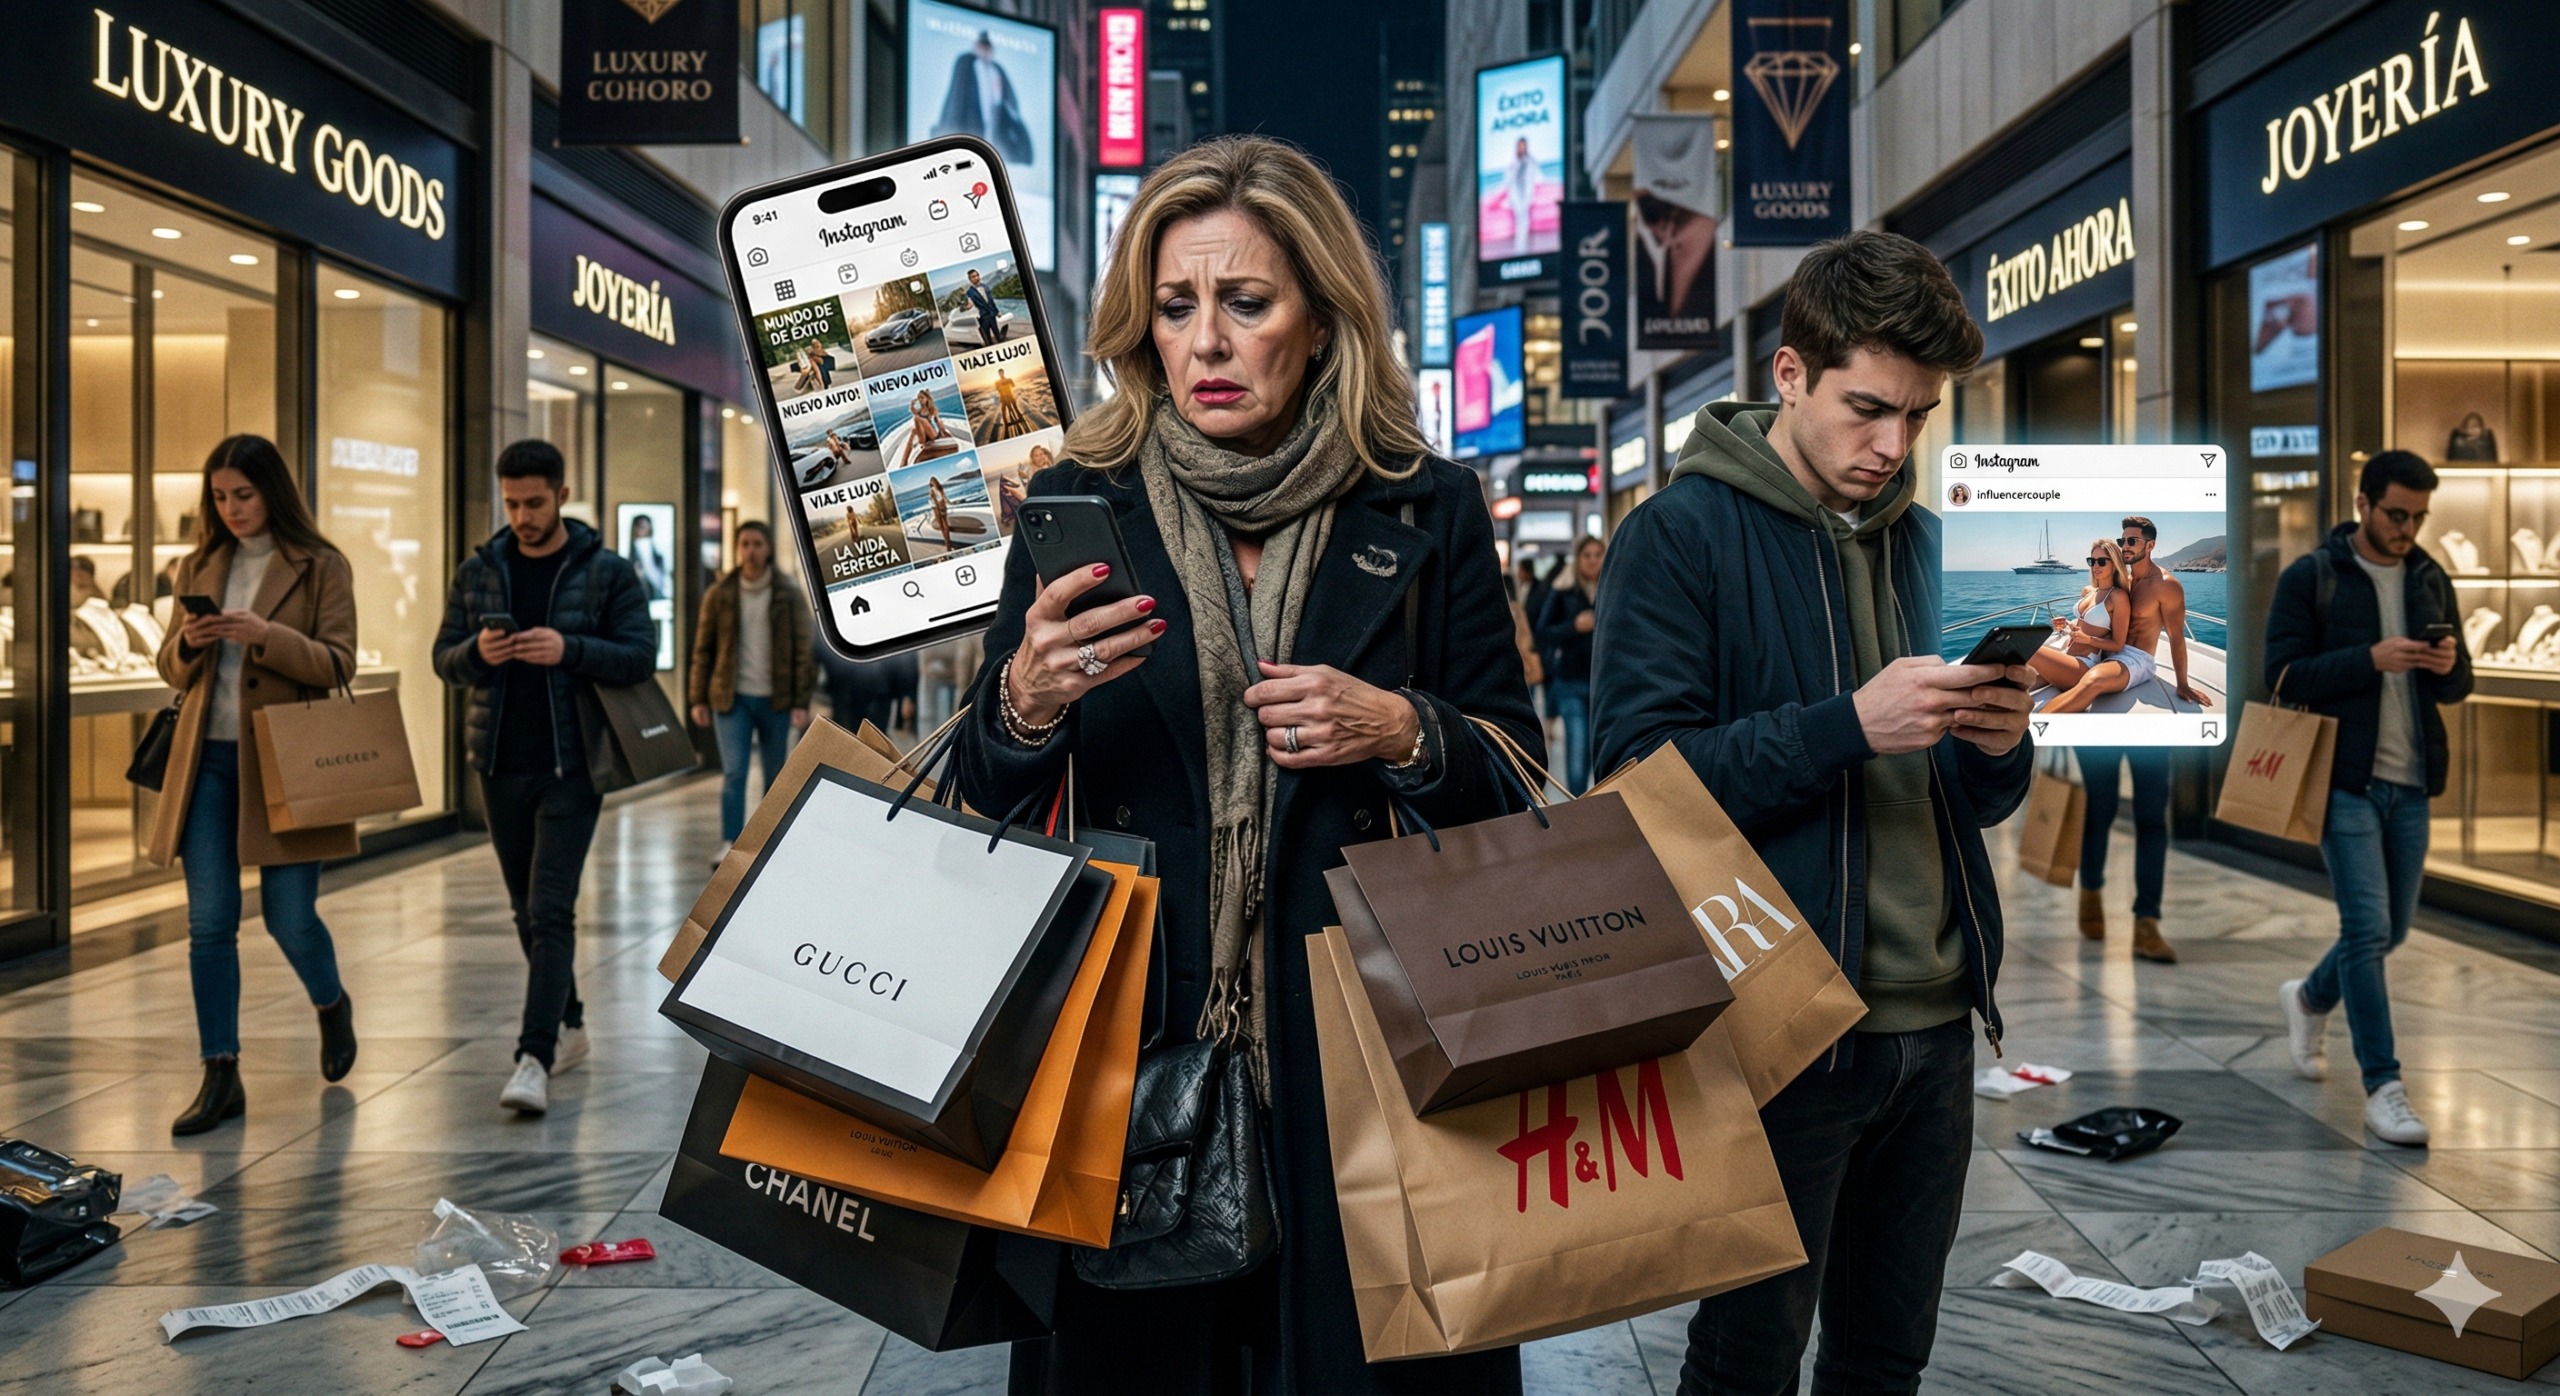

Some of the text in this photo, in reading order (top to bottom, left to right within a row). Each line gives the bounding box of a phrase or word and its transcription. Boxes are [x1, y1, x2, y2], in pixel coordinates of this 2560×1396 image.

[593, 51, 708, 73] LUXURY
[2261, 12, 2489, 194] JOYERÍA
[93, 8, 446, 240] LUXURY GOODS
[1491, 114, 1550, 133] AHORA
[1750, 182, 1834, 199] LUXURY
[752, 210, 778, 225] 9:41
[1754, 201, 1830, 219] GOODS
[818, 213, 907, 248] Instagram
[1986, 197, 2136, 323] ÉXITO AHORA
[572, 254, 676, 346] JOYERÍA
[764, 303, 834, 331] MUNDO DE
[770, 319, 829, 346] DE ÉXITO
[958, 342, 1032, 372] VIAJE LUJO!
[867, 362, 949, 396] NUEVO AUTO!
[781, 388, 861, 419] NUEVO AUTO!
[1974, 453, 2040, 473] Instagram
[810, 479, 884, 509] VIAJE LUJO!
[1976, 489, 2061, 502] influencercouple
[834, 535, 888, 561] LA VIDA
[831, 549, 901, 578] PERFECTA
[1443, 905, 1647, 970] LOUIS VUITTON
[1691, 876, 1802, 984] RA
[793, 943, 908, 1002] GUCCI
[1516, 966, 1548, 980] LOUIS
[850, 1130, 876, 1143] LOUIS
[1496, 1058, 1684, 1213] H&M
[745, 1162, 875, 1242] CHANEL
